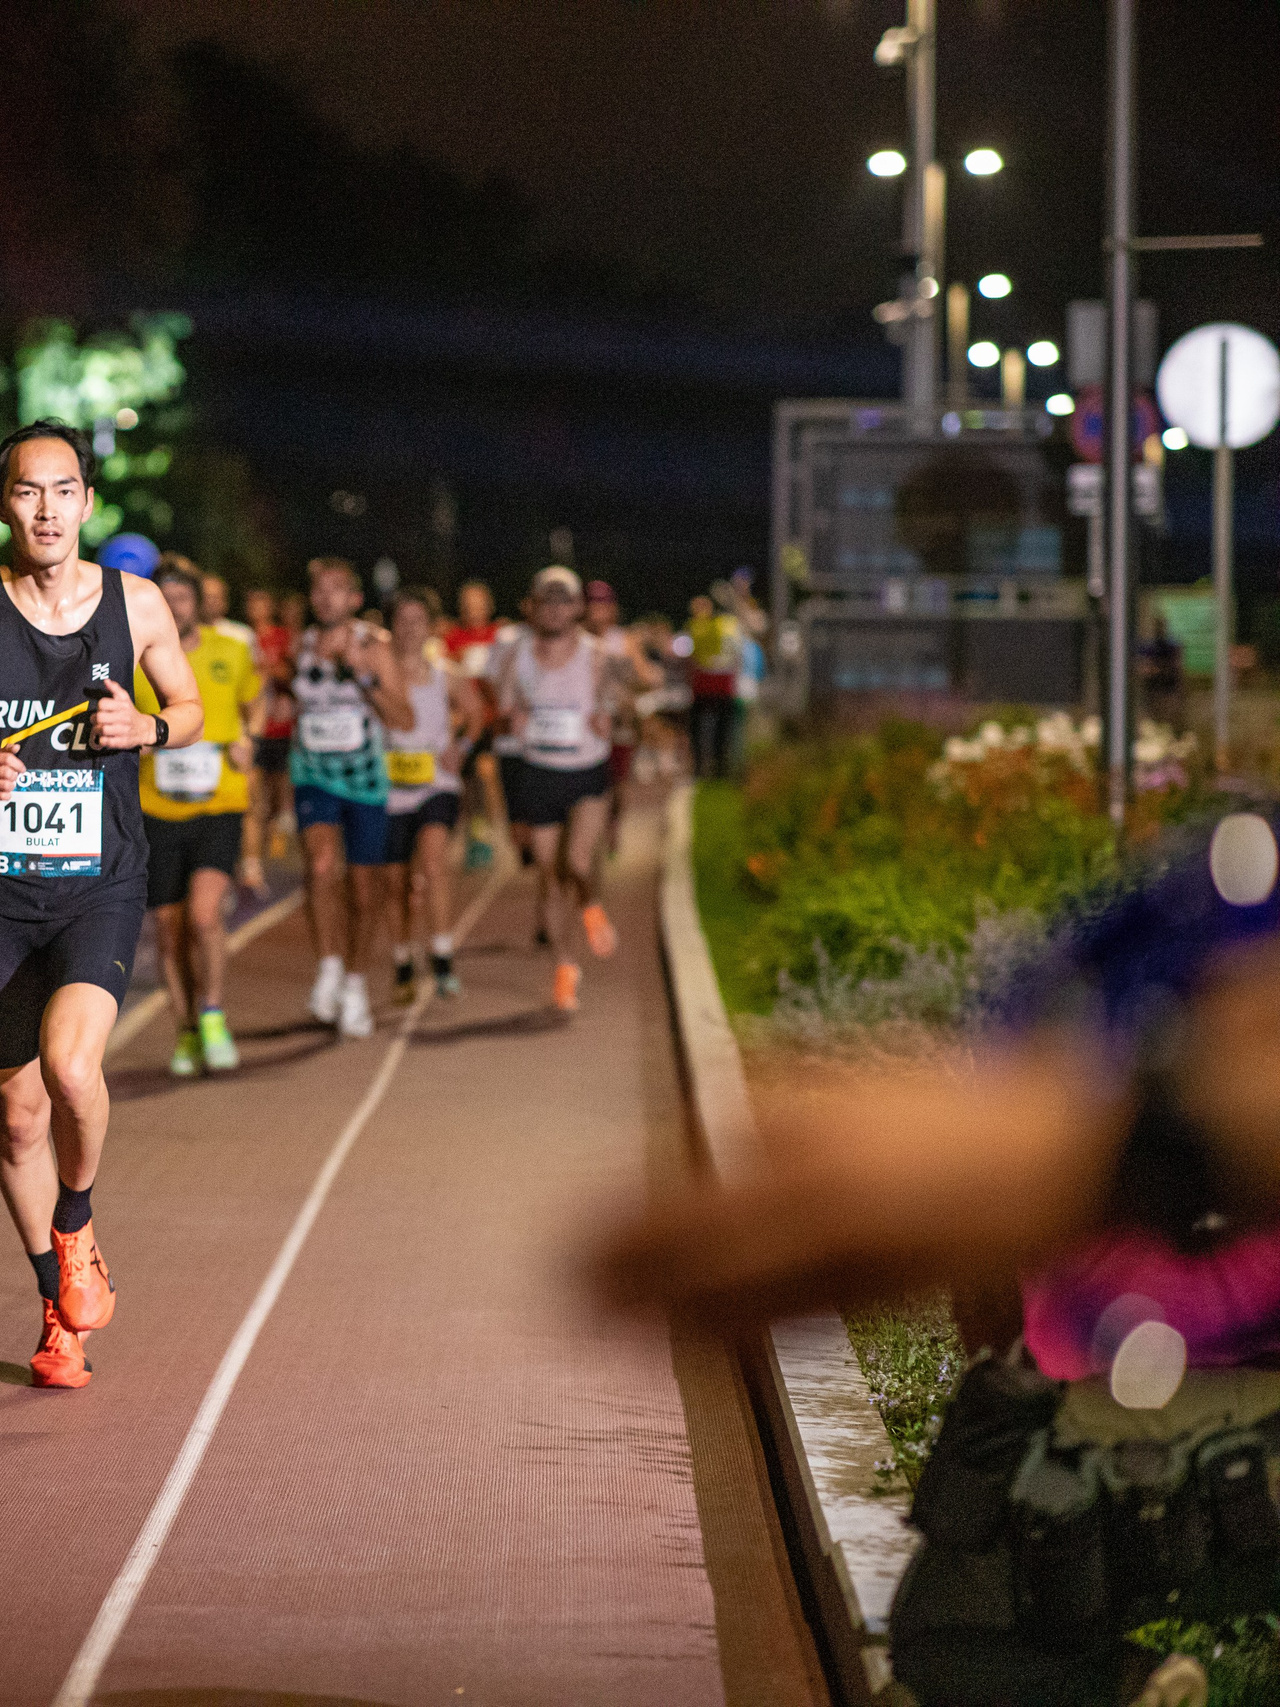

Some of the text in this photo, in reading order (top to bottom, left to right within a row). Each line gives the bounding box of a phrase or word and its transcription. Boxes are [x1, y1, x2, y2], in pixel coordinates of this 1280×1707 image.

[16, 769, 95, 788] ОЧНОЙ
[4, 802, 83, 834] 1041
[26, 837, 60, 847] BULAT
